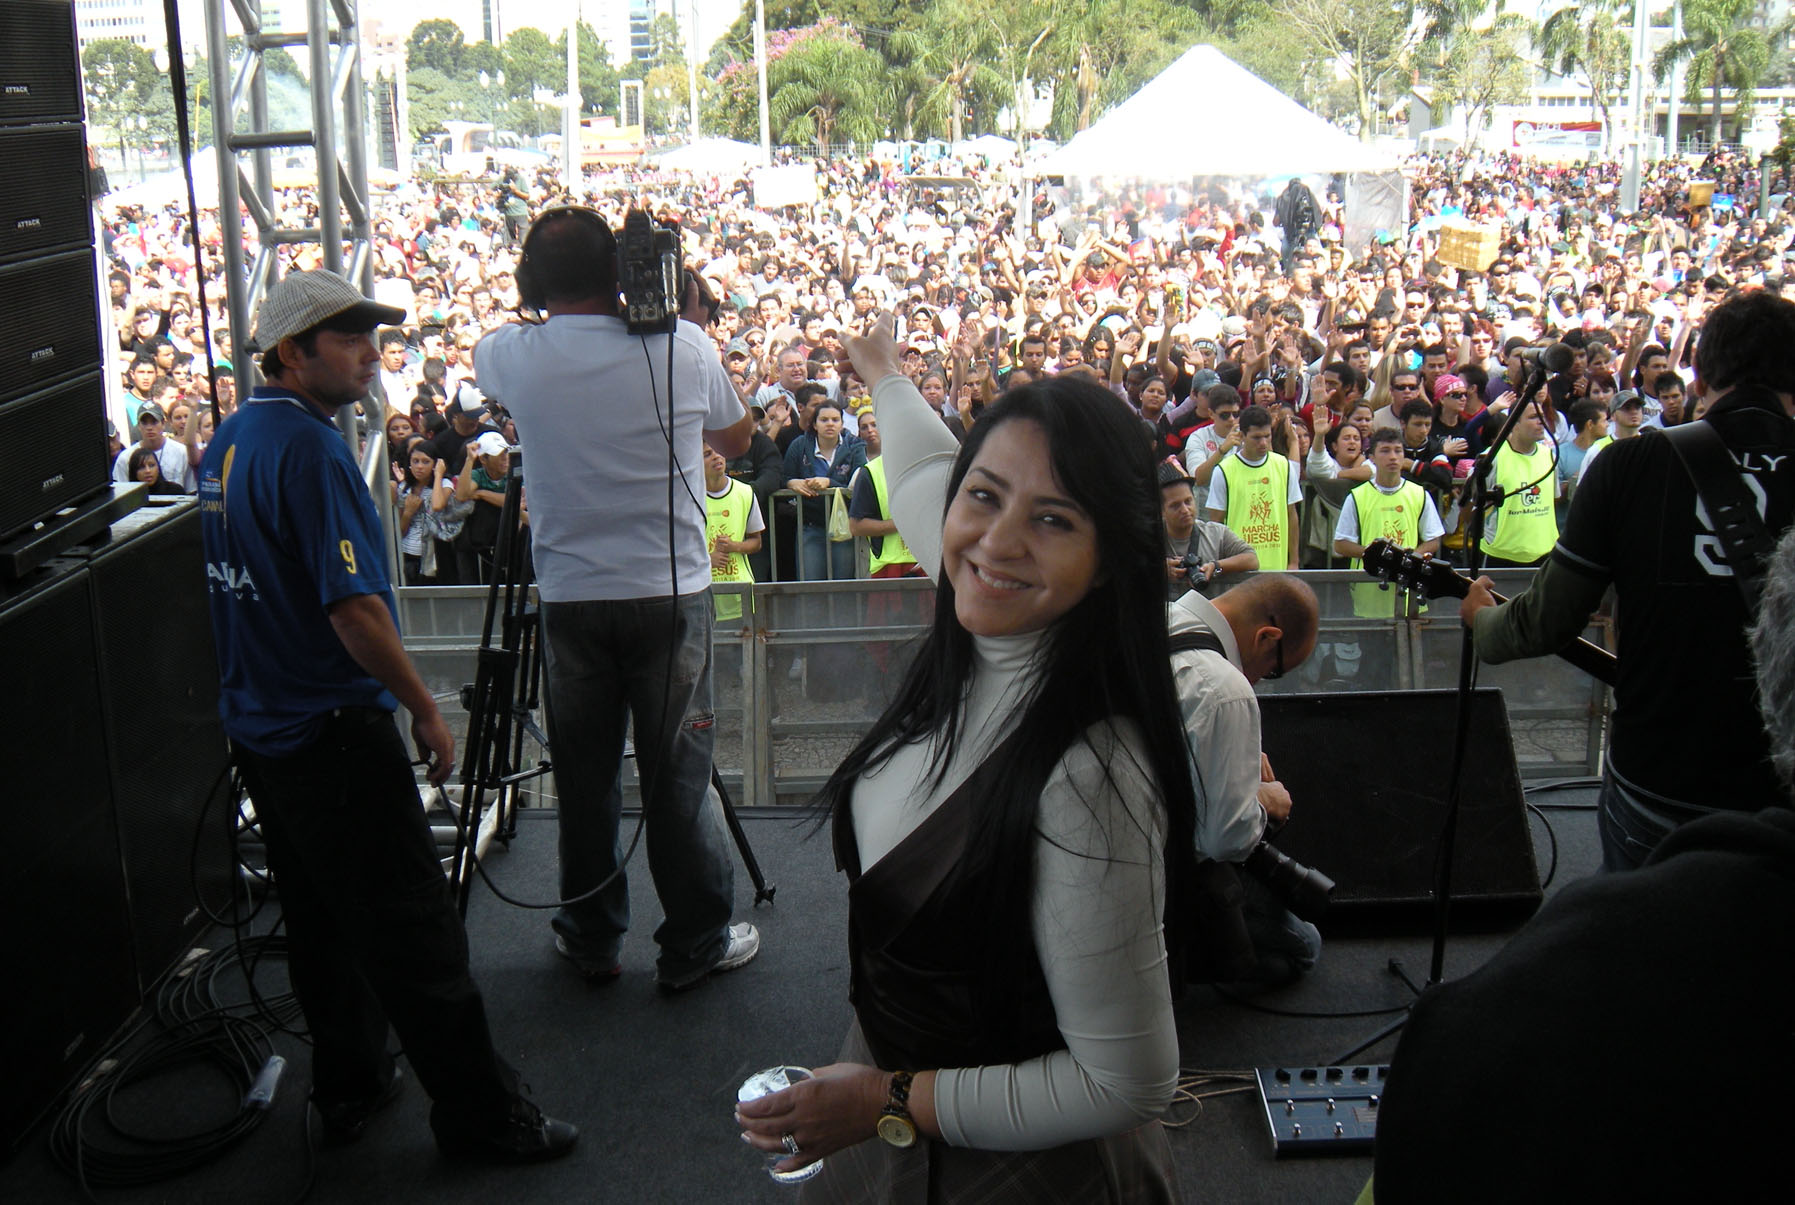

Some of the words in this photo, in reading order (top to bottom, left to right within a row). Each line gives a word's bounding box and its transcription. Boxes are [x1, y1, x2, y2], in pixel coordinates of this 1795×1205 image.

[5, 86, 31, 95] ATTACK
[17, 218, 41, 229] ATTACK
[31, 346, 55, 360] ATTACK
[43, 474, 64, 488] ATTACK
[1242, 523, 1279, 534] MARCHA
[1247, 531, 1281, 544] JESUS
[339, 539, 357, 574] 9
[711, 564, 739, 577] ESUS
